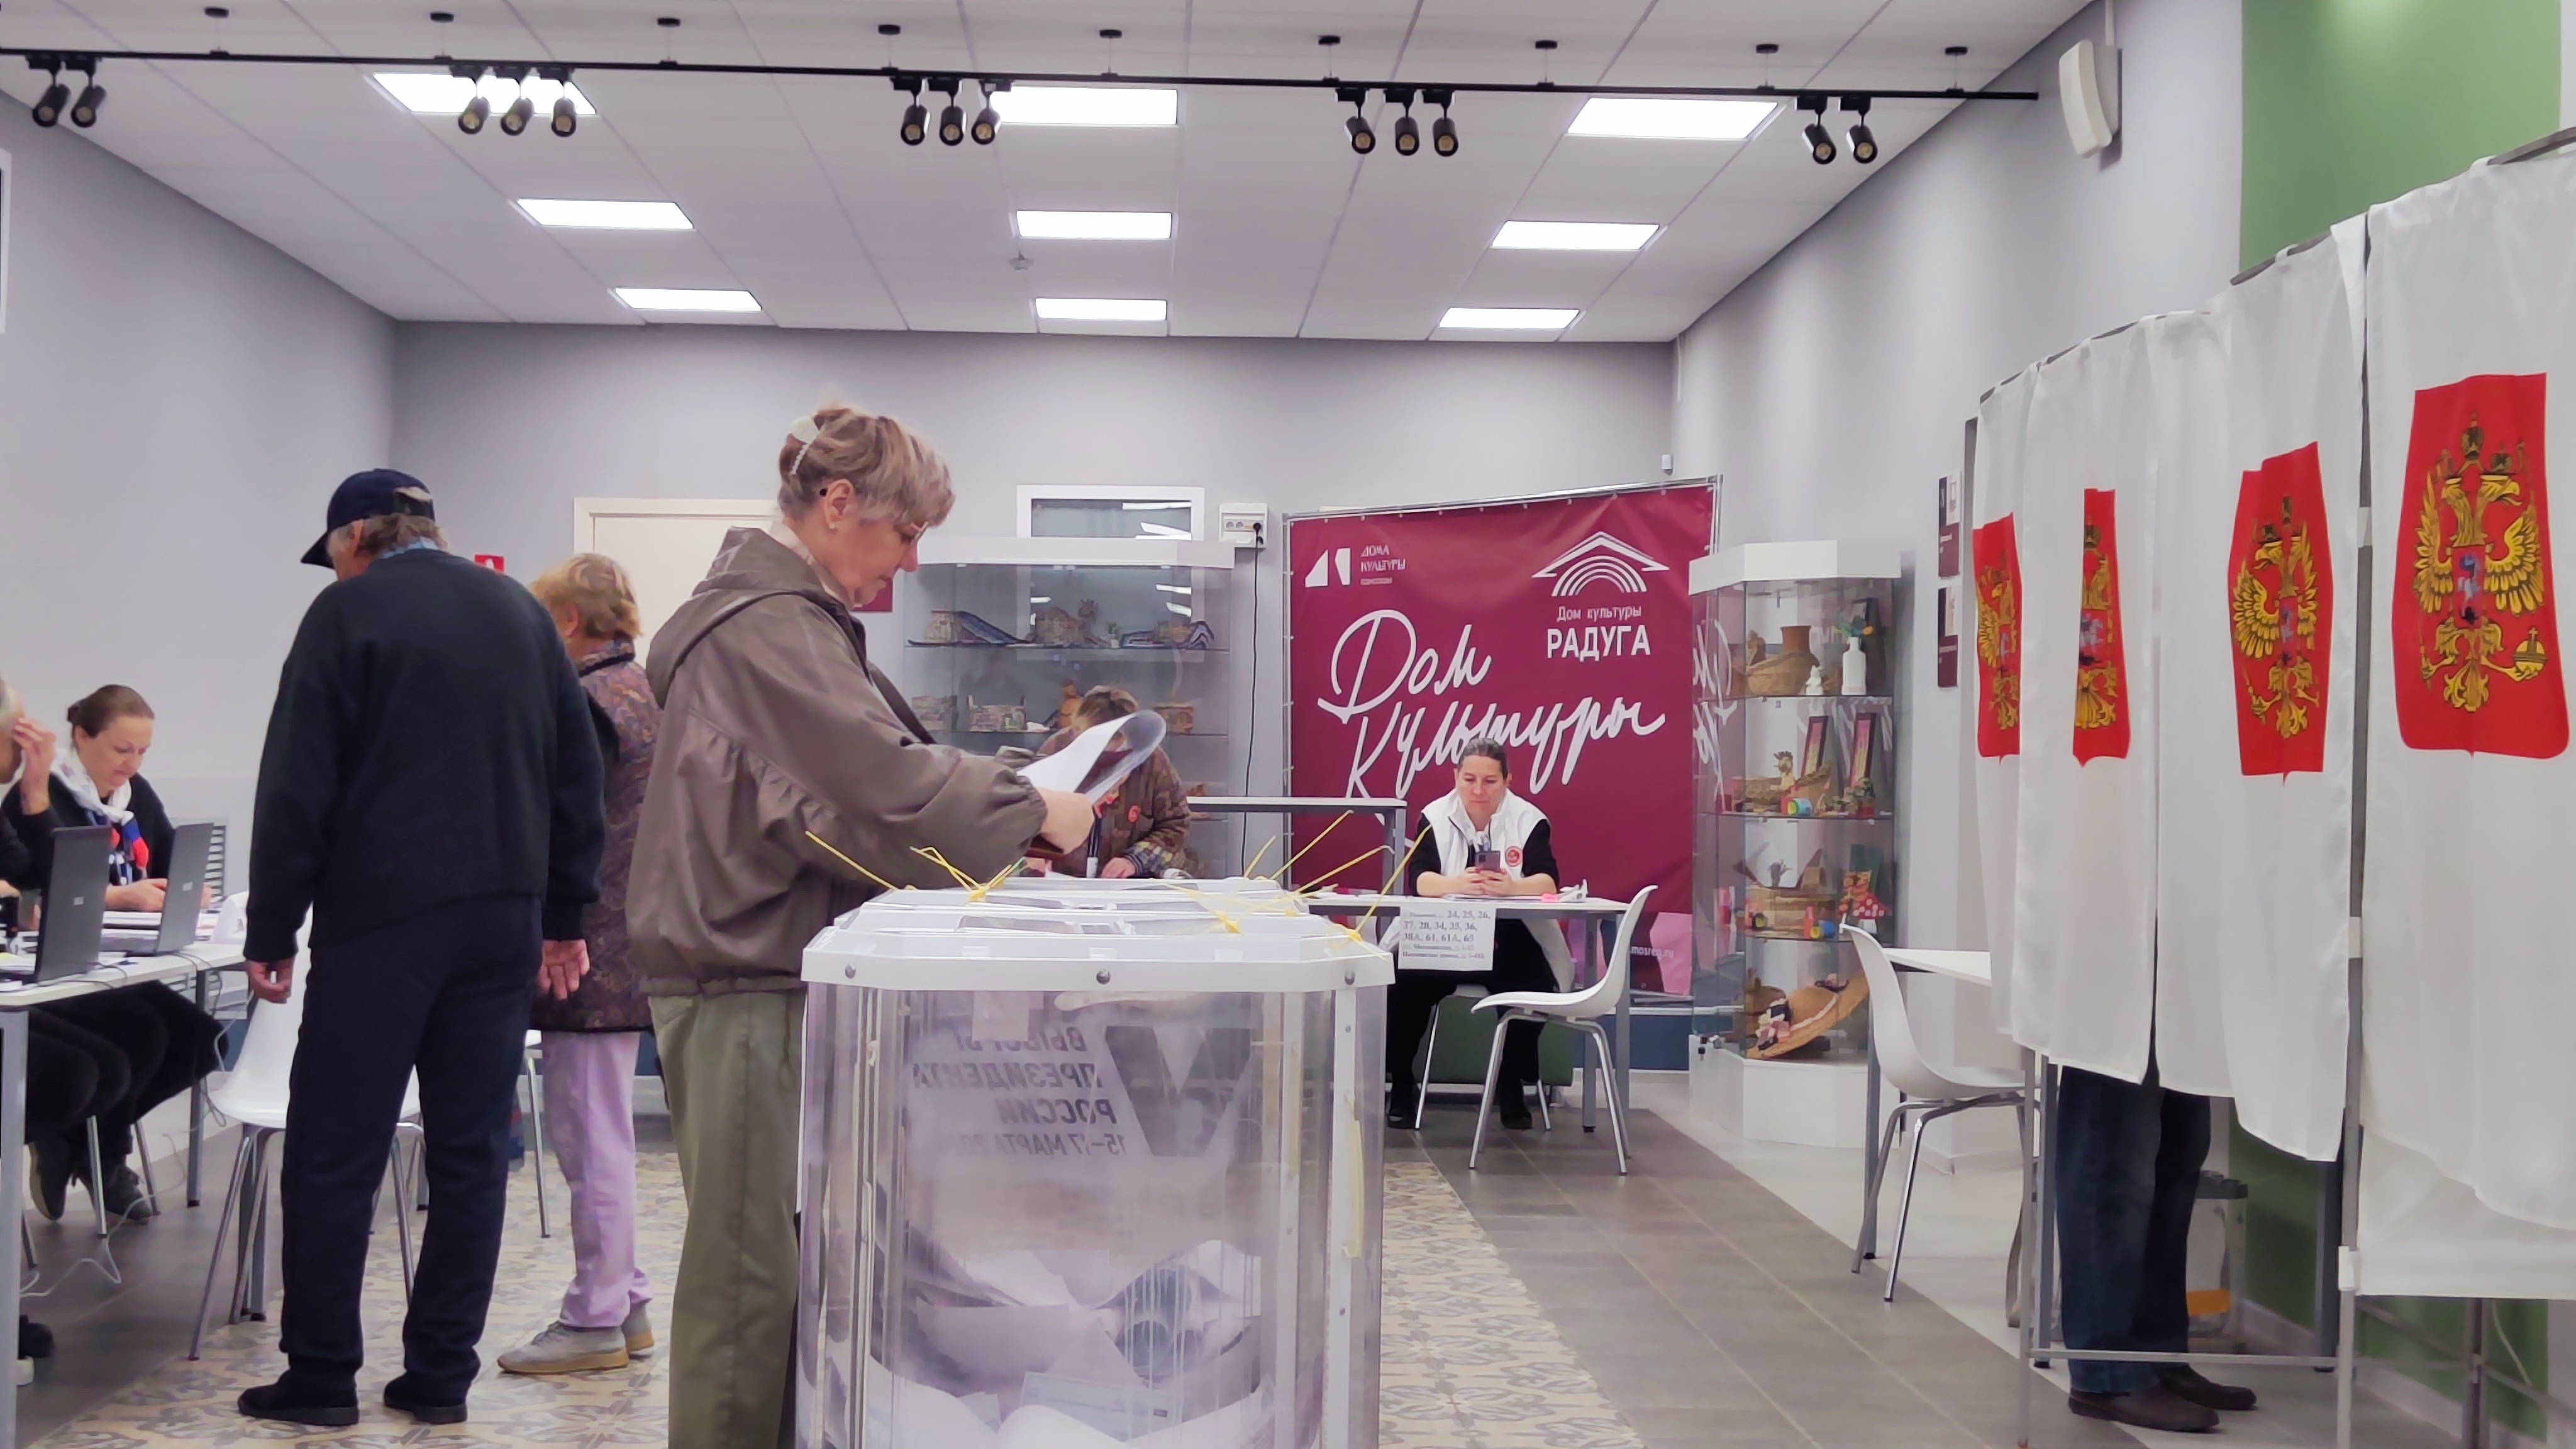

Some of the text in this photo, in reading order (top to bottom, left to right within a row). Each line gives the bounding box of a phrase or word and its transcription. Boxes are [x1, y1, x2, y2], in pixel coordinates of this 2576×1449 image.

[1557, 606, 1642, 622] Дом культуры
[1547, 625, 1651, 662] РАДУГА
[1318, 609, 1492, 724] Дом
